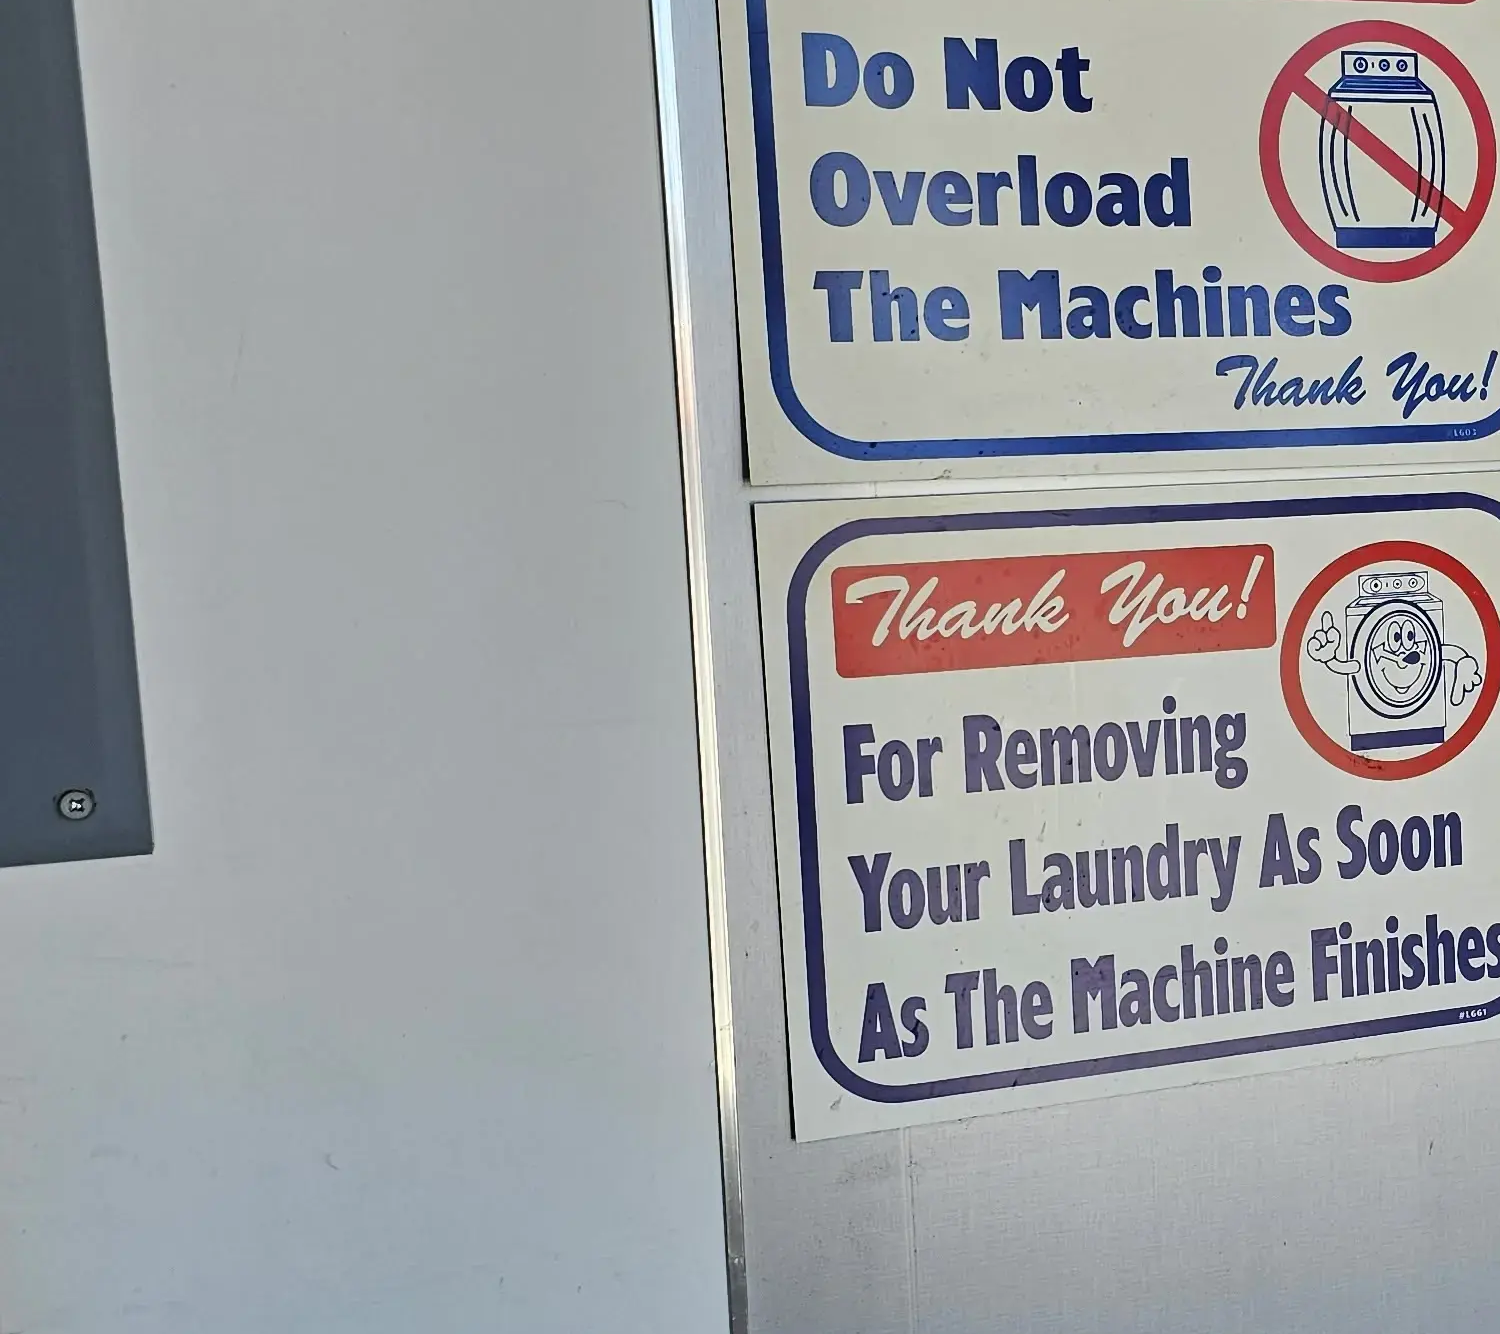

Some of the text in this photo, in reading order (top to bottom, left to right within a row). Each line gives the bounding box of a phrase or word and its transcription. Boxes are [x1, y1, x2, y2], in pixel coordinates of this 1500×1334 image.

[801, 31, 1094, 114] Do Not
[809, 150, 1192, 230] Overload
[812, 264, 1354, 344] The Machines
[1215, 349, 1499, 421] Thank You!
[844, 554, 1265, 648] Thank You!
[842, 695, 1249, 805] For Removing
[848, 804, 1464, 933] Your Laundry As Soon
[857, 981, 931, 1064] As
[944, 967, 1054, 1051] The
[1070, 937, 1295, 1033] Machine
